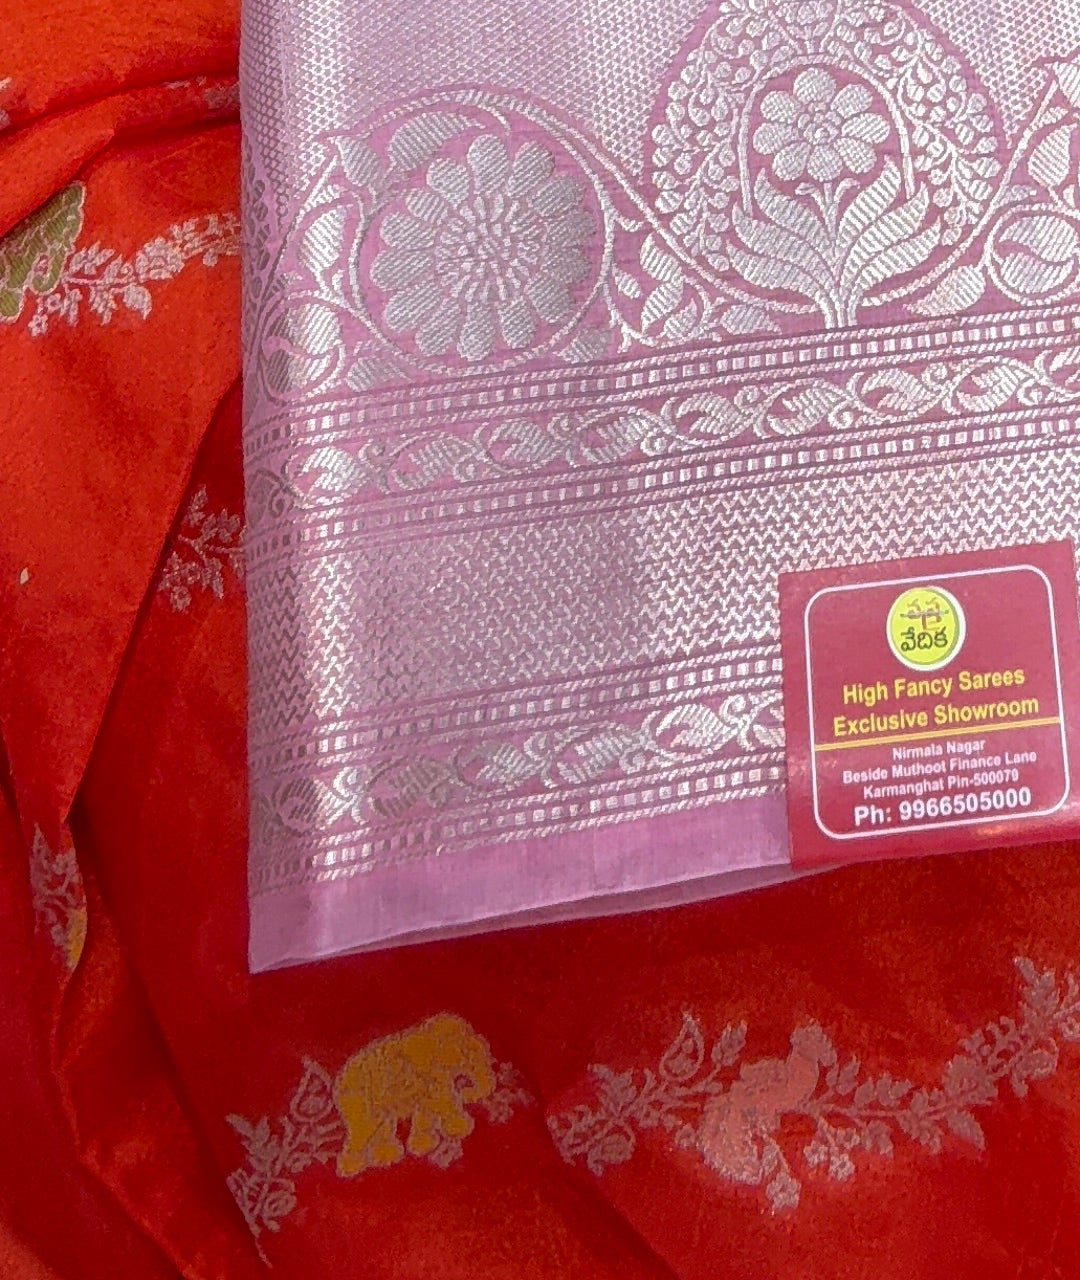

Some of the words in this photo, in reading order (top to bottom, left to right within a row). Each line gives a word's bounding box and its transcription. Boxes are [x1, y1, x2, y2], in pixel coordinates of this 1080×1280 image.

[900, 626, 948, 652] వేదిక
[843, 682, 888, 707] High
[894, 677, 953, 699] Fancy
[958, 669, 1025, 691] Sarees
[833, 709, 928, 737] Exclusive
[934, 697, 1039, 725] Showroom
[892, 744, 943, 761] Nirmala
[946, 740, 986, 755] Nagar
[842, 767, 888, 784] Beside
[891, 762, 946, 778] Muthoot
[949, 756, 1001, 772] Finance
[1004, 751, 1037, 765] Lane
[863, 778, 944, 800] Karmanghat
[854, 804, 892, 826] Ph:
[899, 786, 1032, 821] 9966505000
